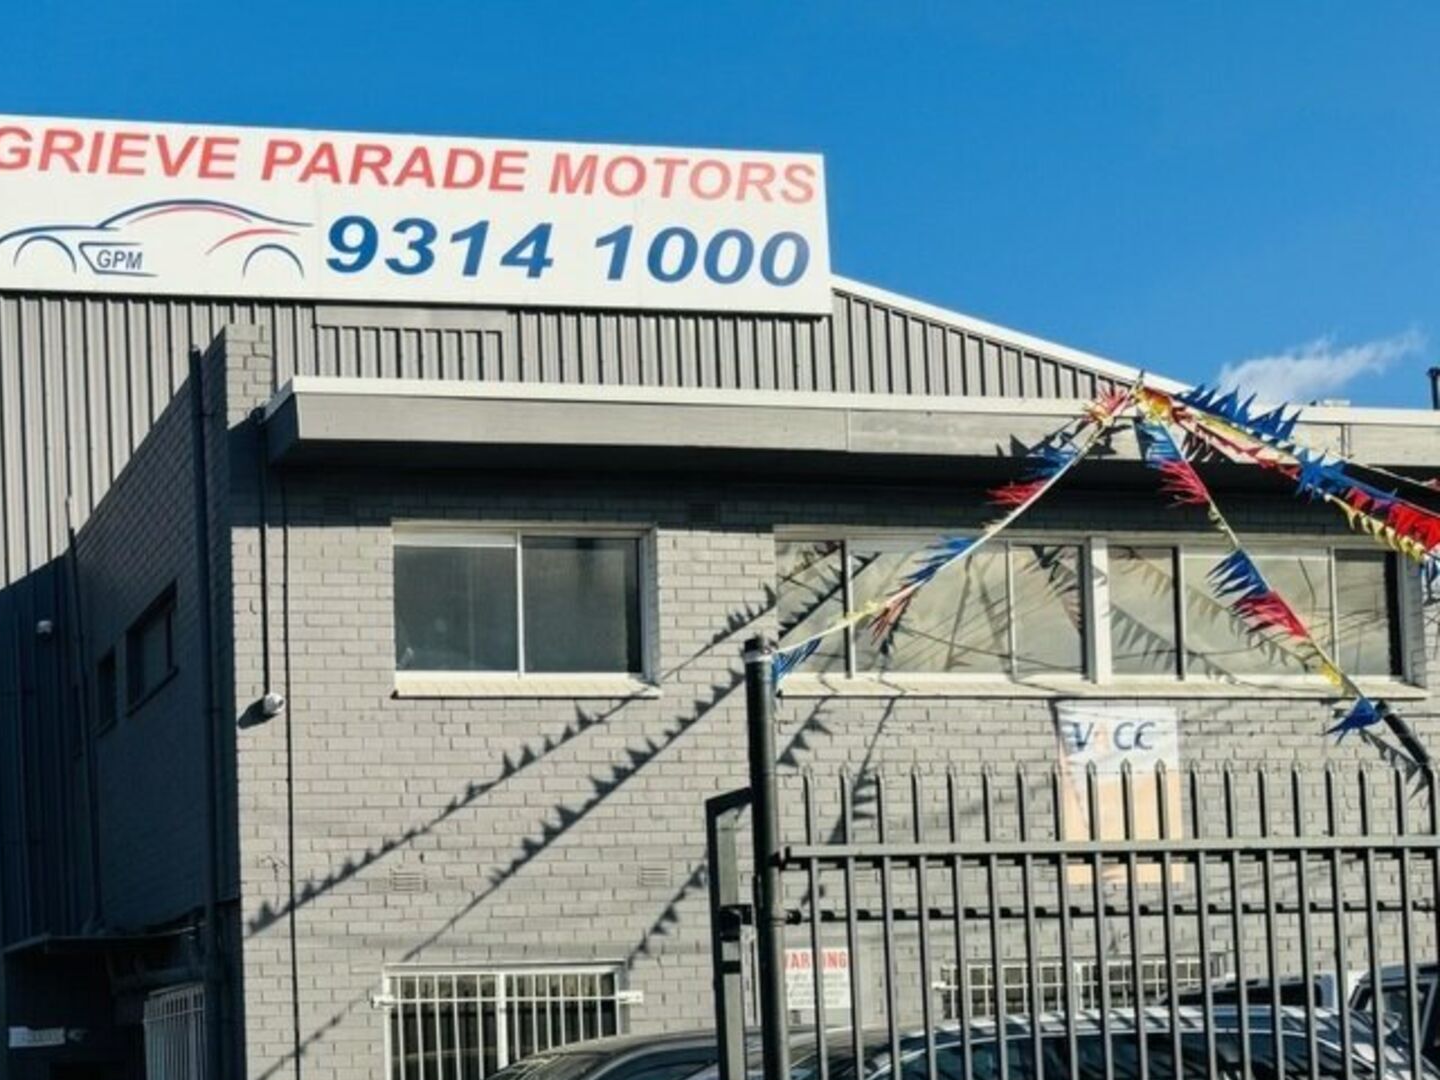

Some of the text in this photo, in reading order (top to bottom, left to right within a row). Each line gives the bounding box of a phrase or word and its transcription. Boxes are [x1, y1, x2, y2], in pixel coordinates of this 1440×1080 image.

[260, 138, 530, 192] PARADE
[548, 151, 816, 204] MOTORS
[96, 249, 144, 271] GPM
[326, 215, 812, 286] 9314 1000
